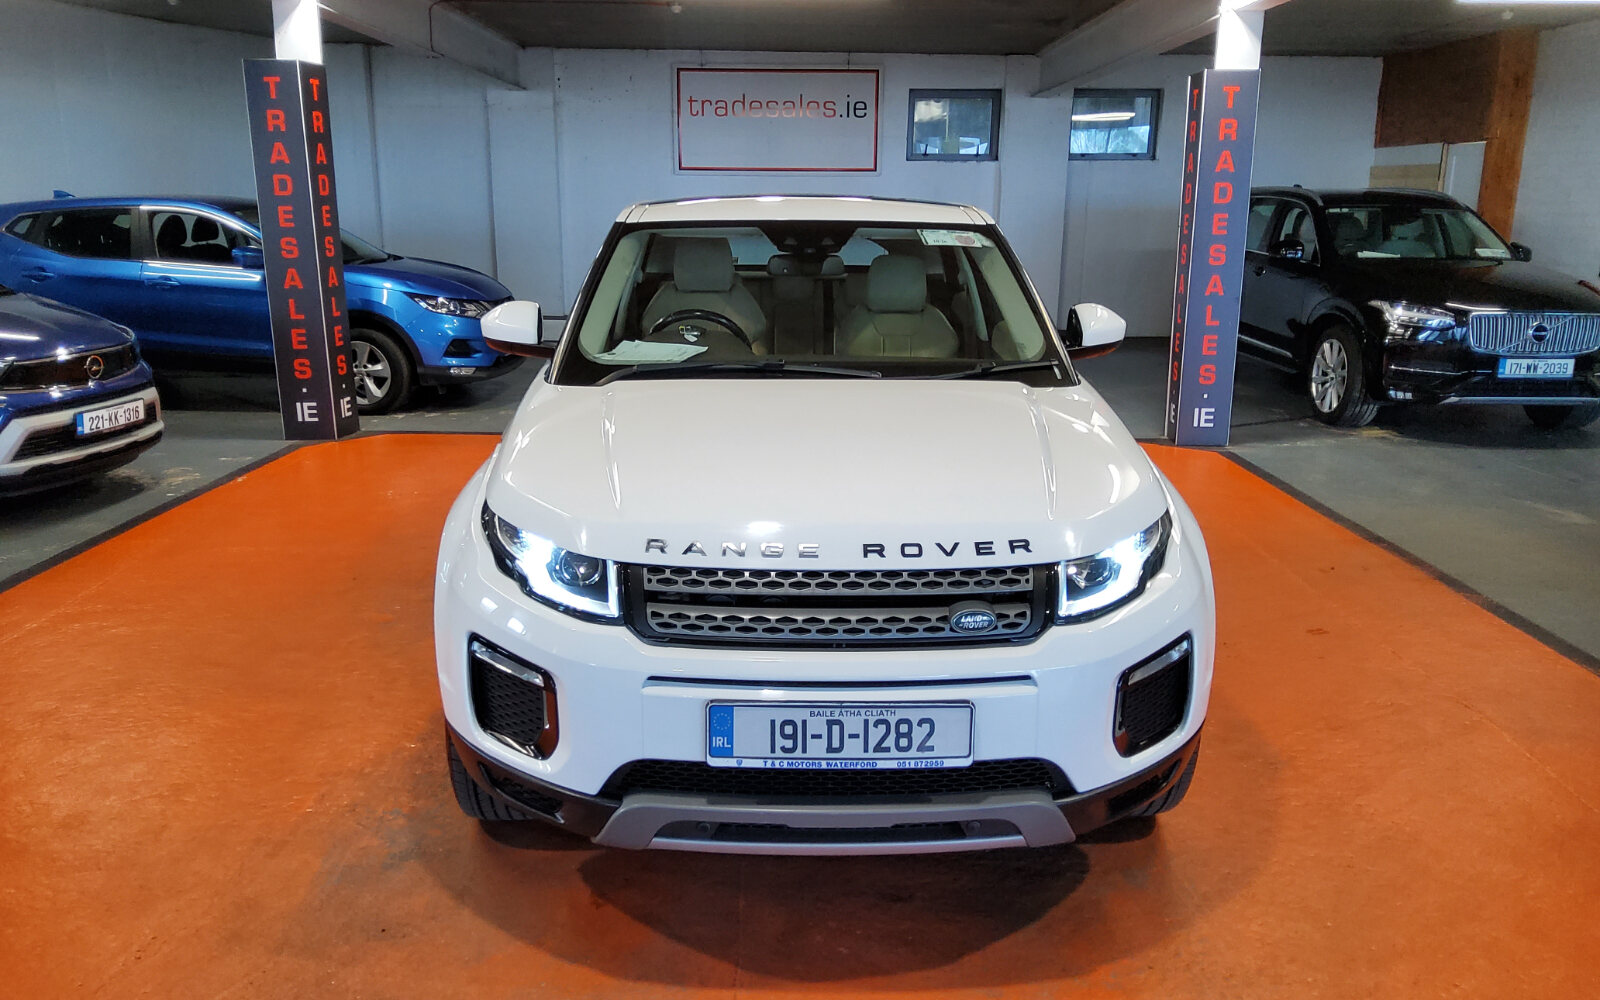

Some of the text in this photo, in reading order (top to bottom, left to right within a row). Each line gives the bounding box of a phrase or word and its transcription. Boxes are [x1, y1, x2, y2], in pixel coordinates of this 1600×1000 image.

[688, 93, 868, 119] tradesales.ie
[88, 406, 140, 431] 221-KK-1316
[644, 538, 1033, 559] RANGE ROVER
[963, 621, 989, 629] ROVER
[809, 710, 835, 718] BAILE
[864, 709, 896, 717] CLIATH
[712, 736, 731, 748] IRL
[770, 718, 935, 754] 191-D-1282
[913, 760, 945, 768] 872959
